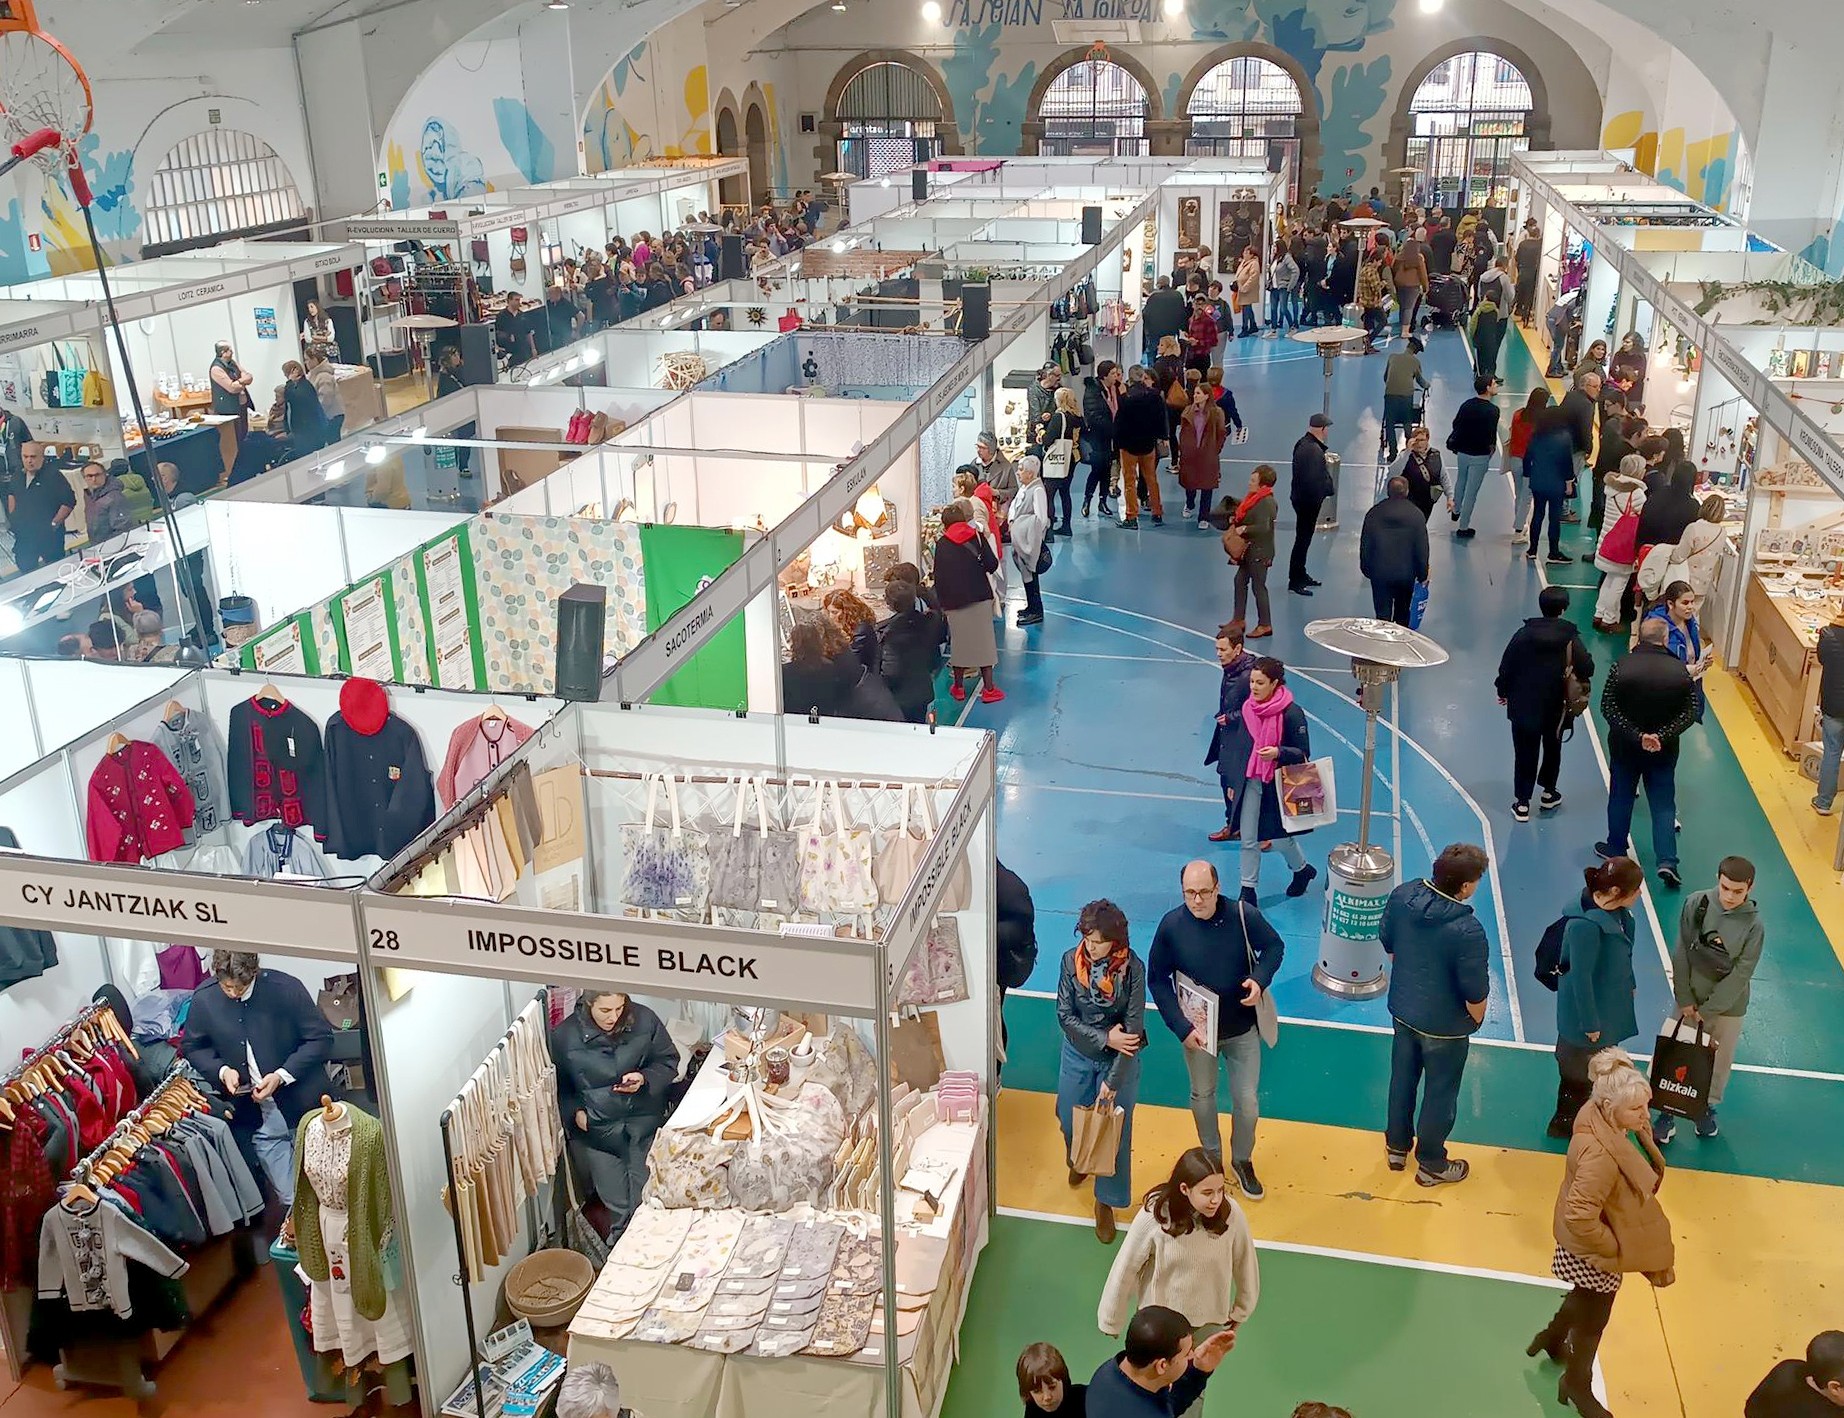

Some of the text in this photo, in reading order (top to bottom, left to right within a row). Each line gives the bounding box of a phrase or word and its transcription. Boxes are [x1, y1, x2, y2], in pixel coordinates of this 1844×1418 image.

[397, 226, 421, 234] TALLER
[423, 226, 431, 234] DE
[432, 226, 456, 234] CUERO
[666, 605, 714, 658] SACOTERMIA
[909, 795, 973, 932] IMPOSSIBLE BLACK
[21, 884, 54, 905] CY
[63, 889, 188, 920] JANTZIAK
[370, 929, 759, 980] 28 IMPOSSIBLE BLACK
